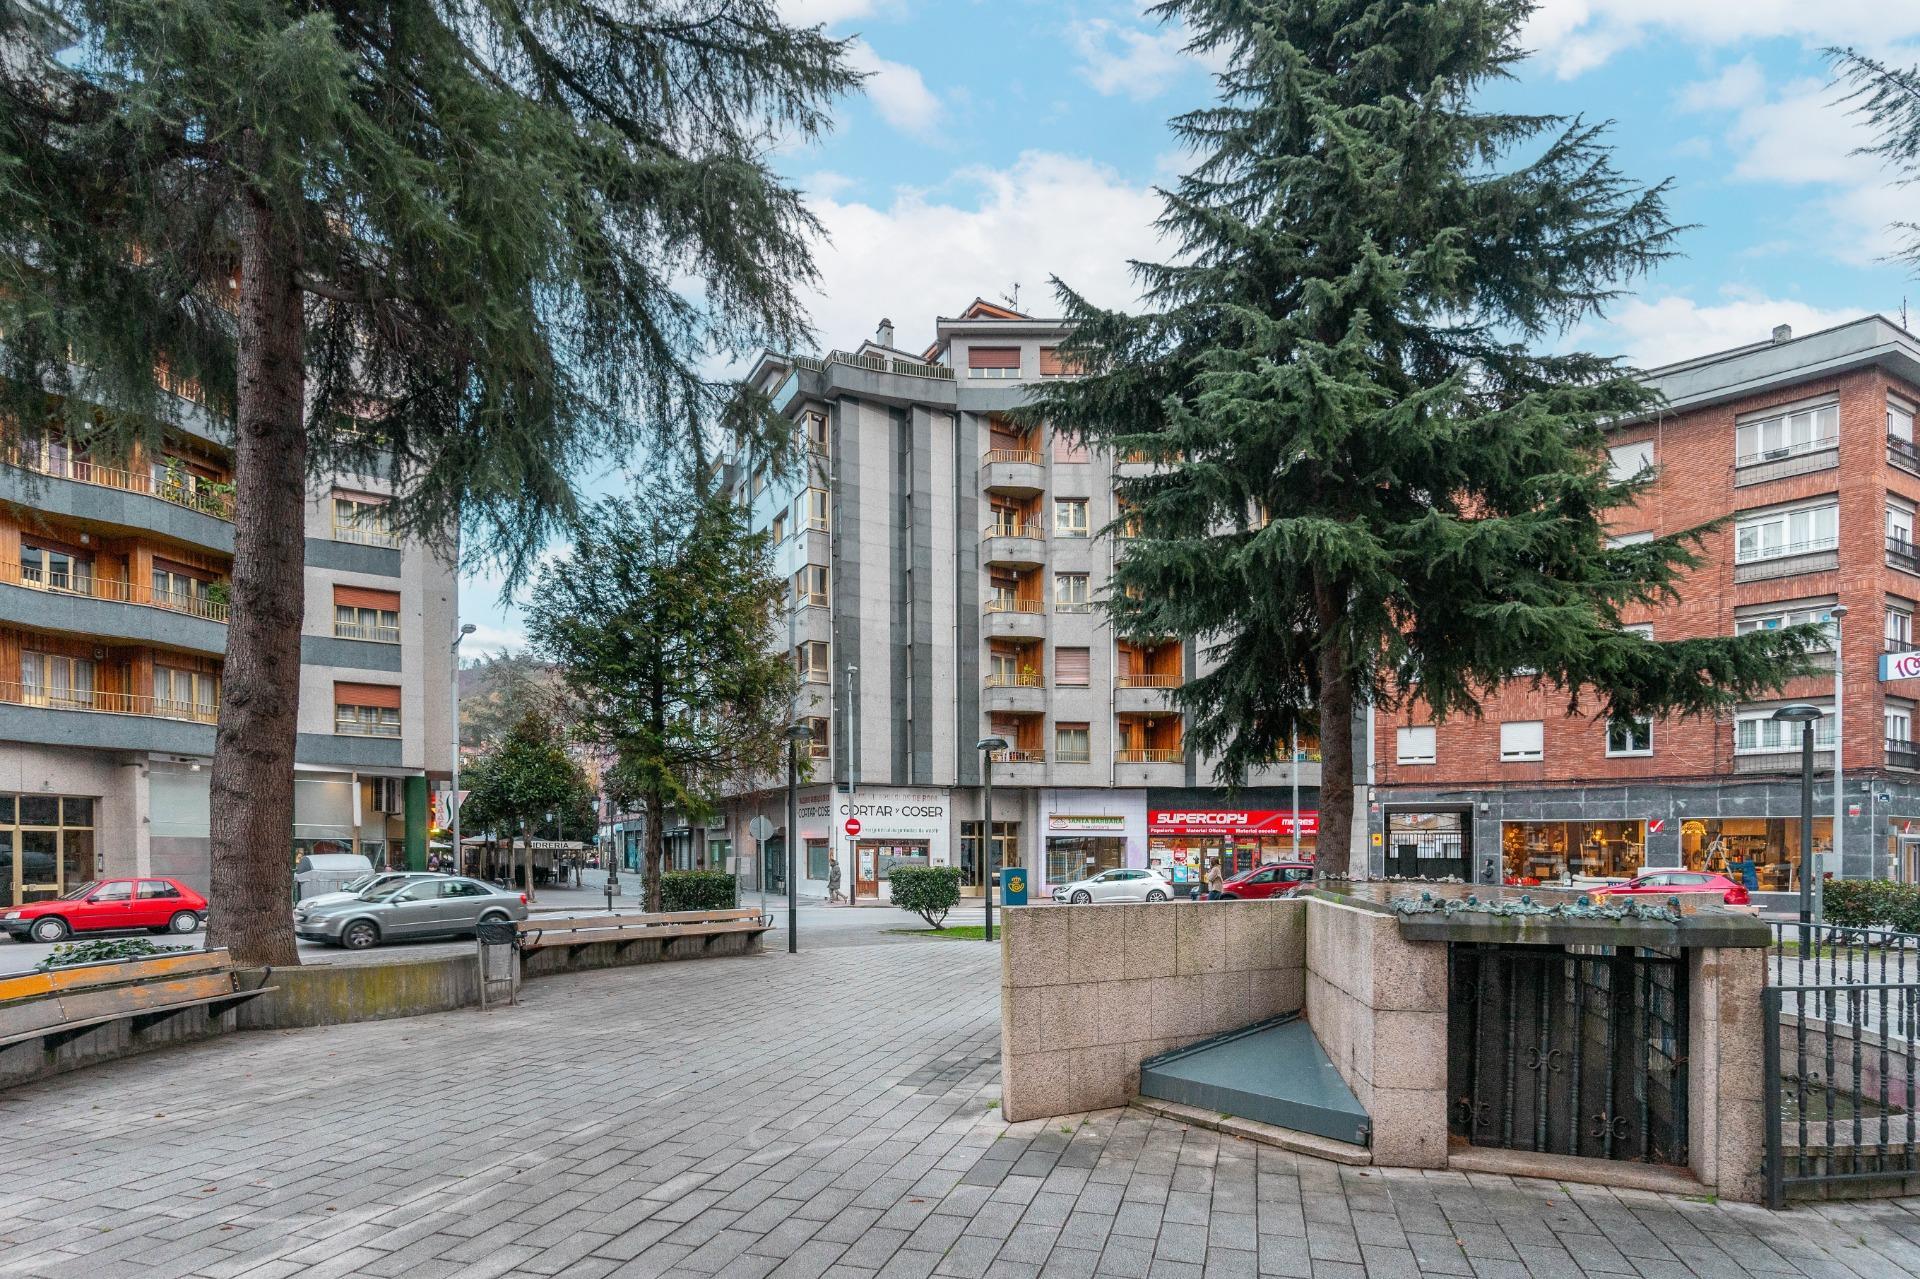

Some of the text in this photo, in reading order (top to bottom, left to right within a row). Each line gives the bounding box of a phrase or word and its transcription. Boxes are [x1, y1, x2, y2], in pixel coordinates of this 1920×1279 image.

[840, 804, 892, 817] CORTAR
[901, 806, 943, 818] COSER
[1156, 813, 1248, 824] SUPERCOPY
[1281, 818, 1315, 826] MIRES
[532, 841, 569, 849] IDRERIA
